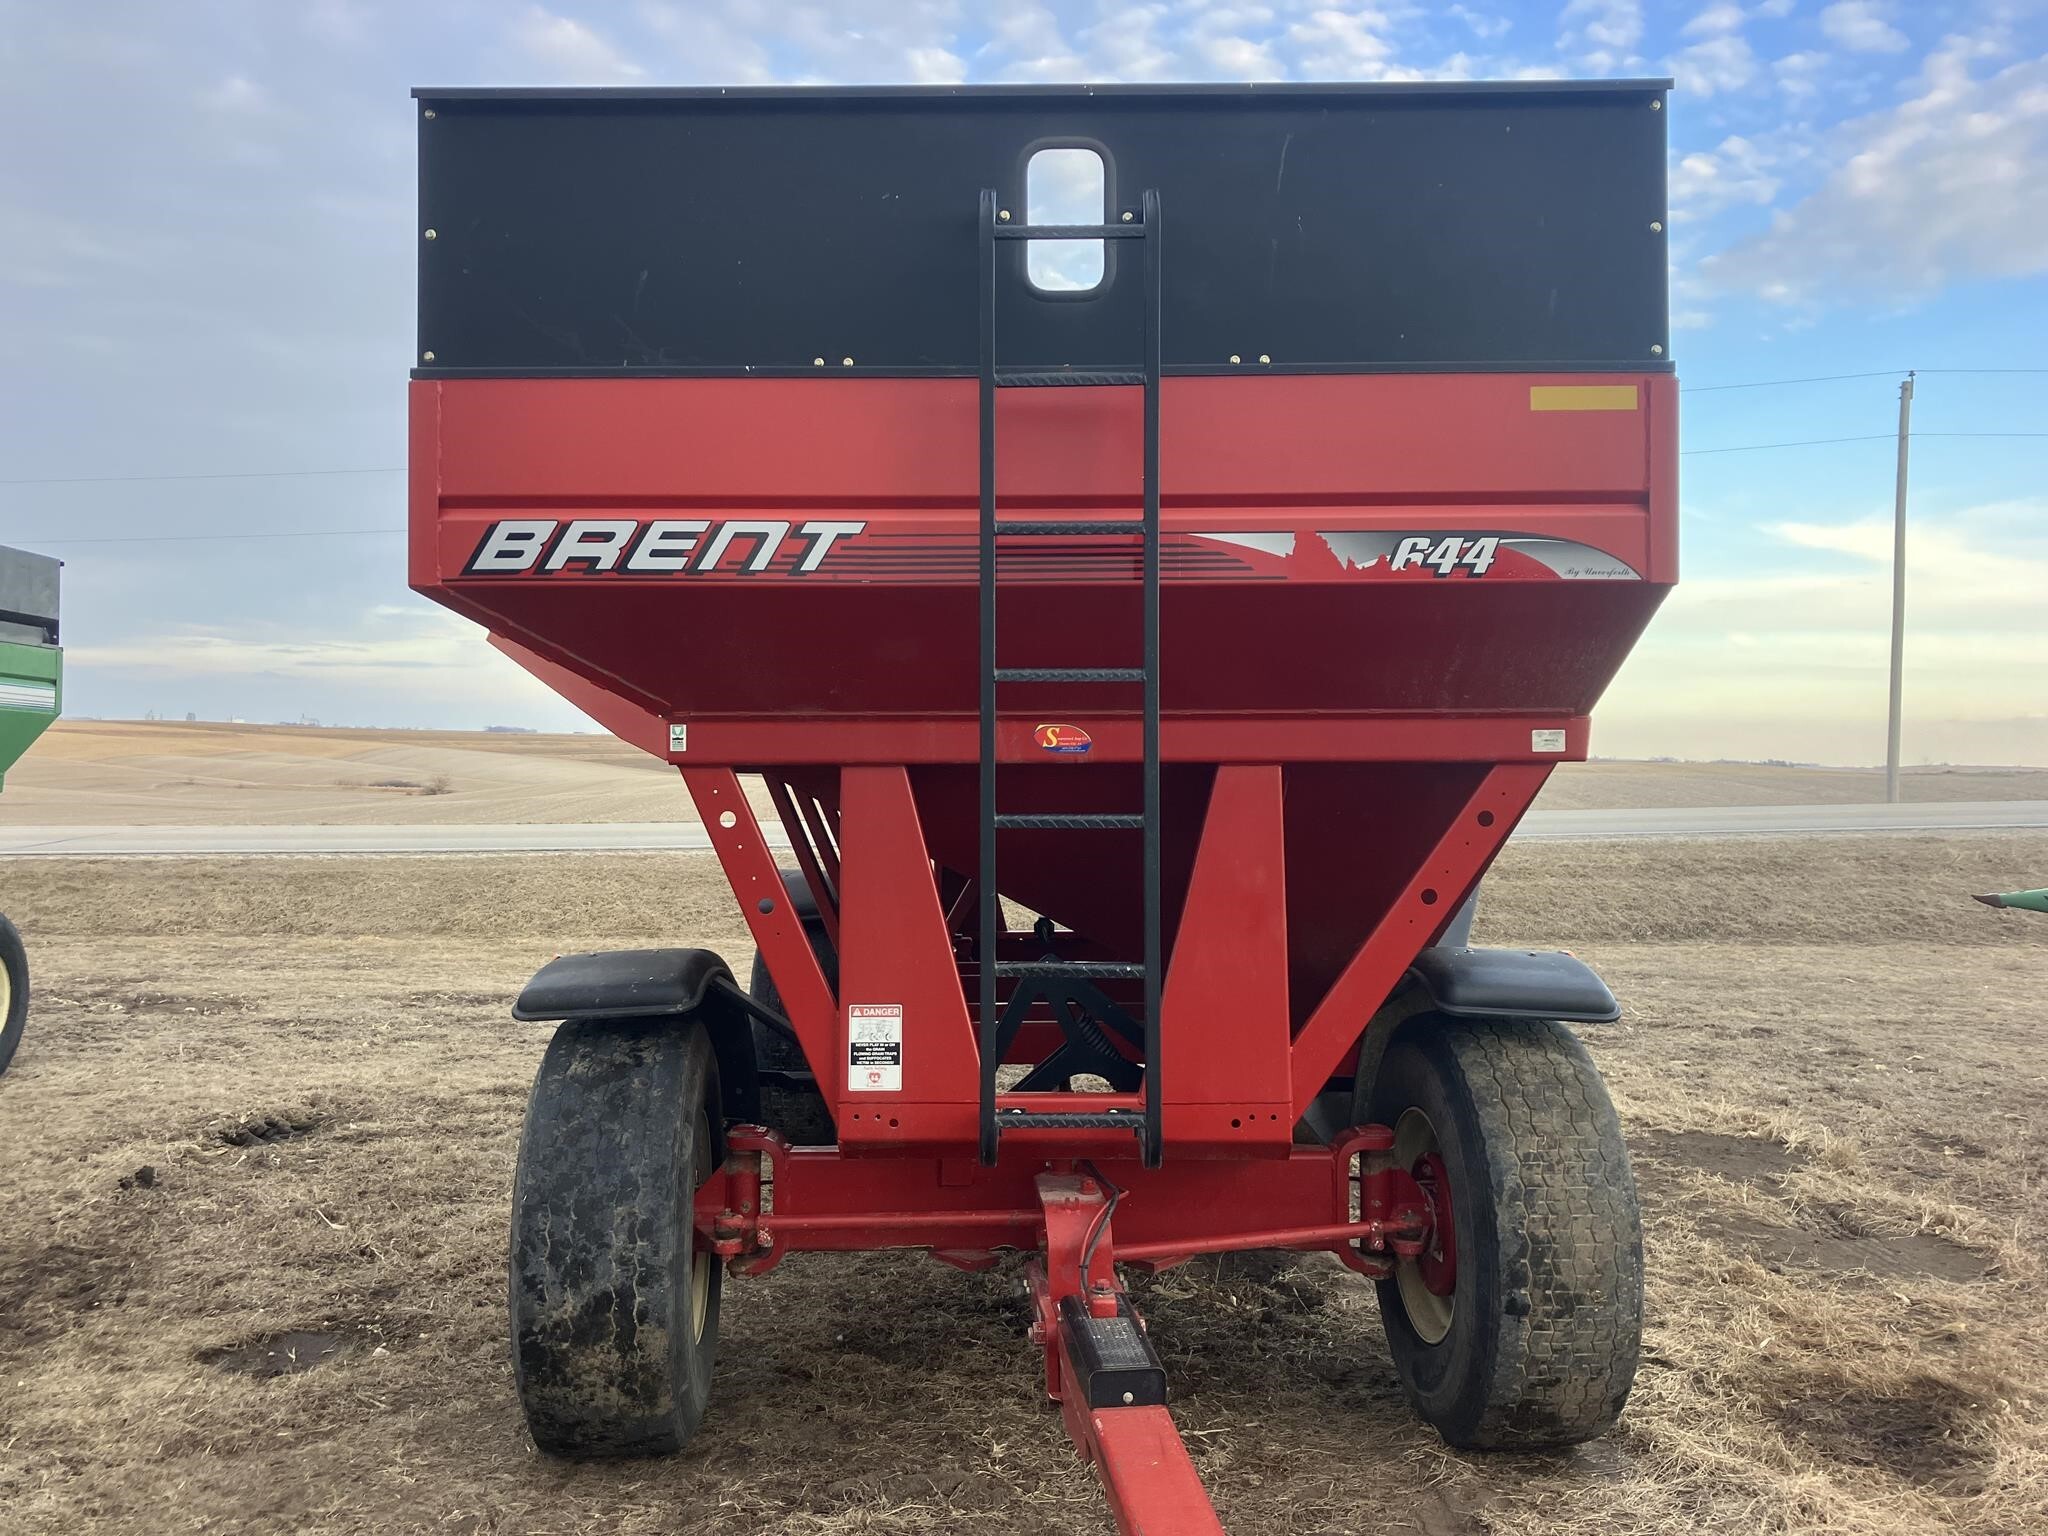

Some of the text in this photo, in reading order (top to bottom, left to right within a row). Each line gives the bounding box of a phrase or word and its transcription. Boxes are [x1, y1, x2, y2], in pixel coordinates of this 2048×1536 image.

[464, 519, 868, 574] BRENT
[1390, 536, 1500, 575] 644
[1565, 567, 1580, 577] By
[863, 1008, 899, 1016] DANGER
